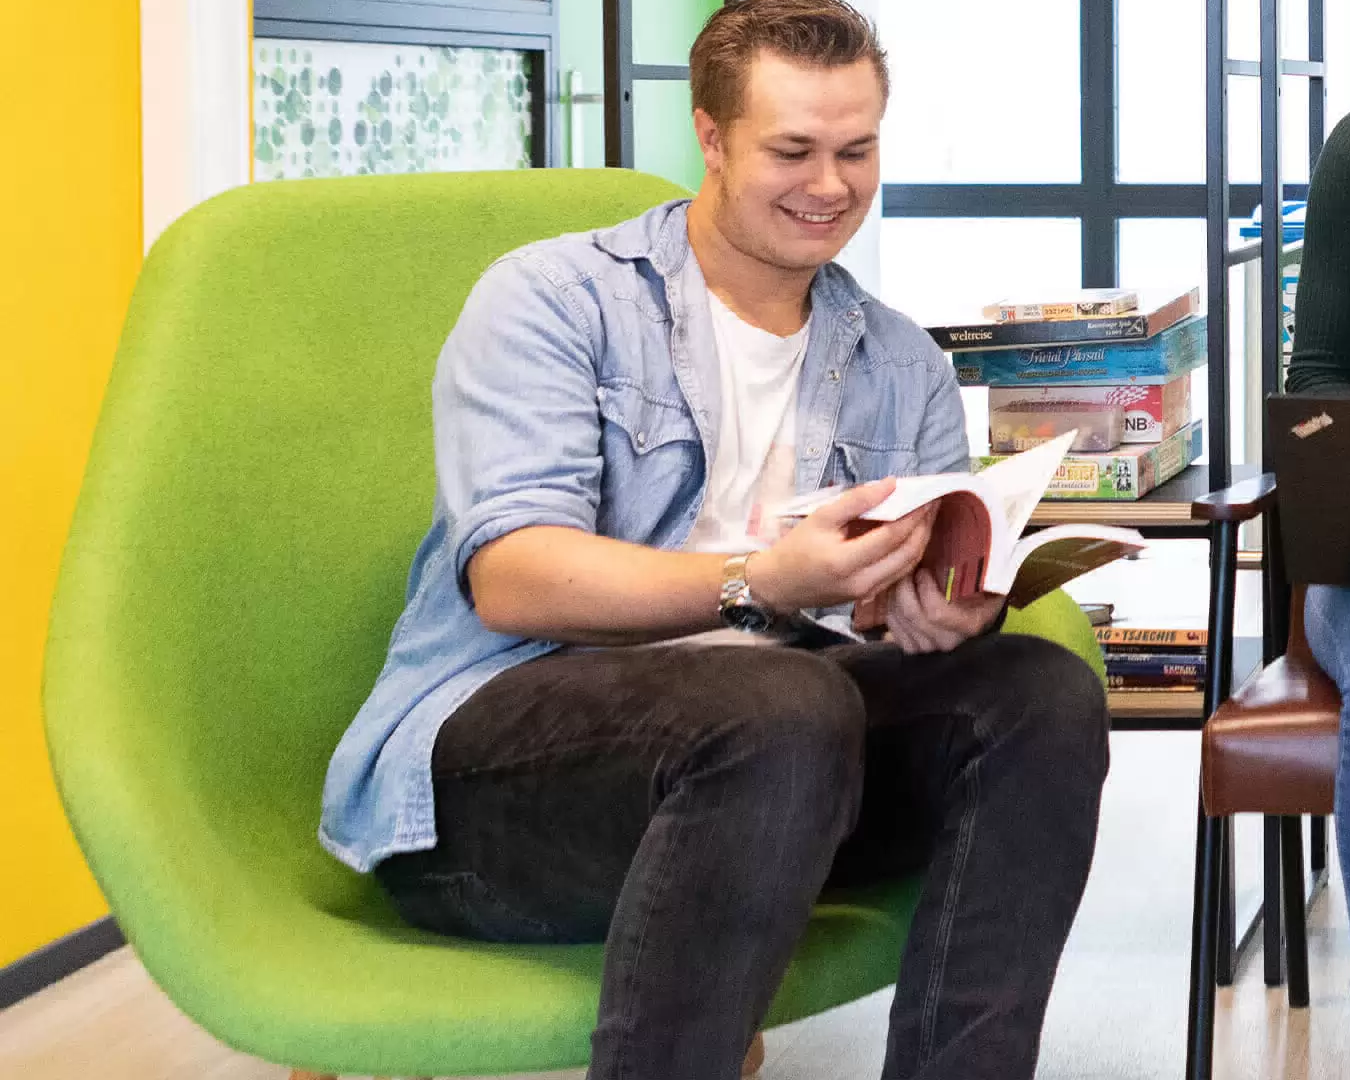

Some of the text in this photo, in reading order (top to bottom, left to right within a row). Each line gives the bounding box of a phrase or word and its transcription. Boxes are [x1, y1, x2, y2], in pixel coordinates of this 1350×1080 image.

[949, 330, 993, 341] weltreise
[1020, 350, 1061, 365] Trivial
[1096, 629, 1111, 640] AG
